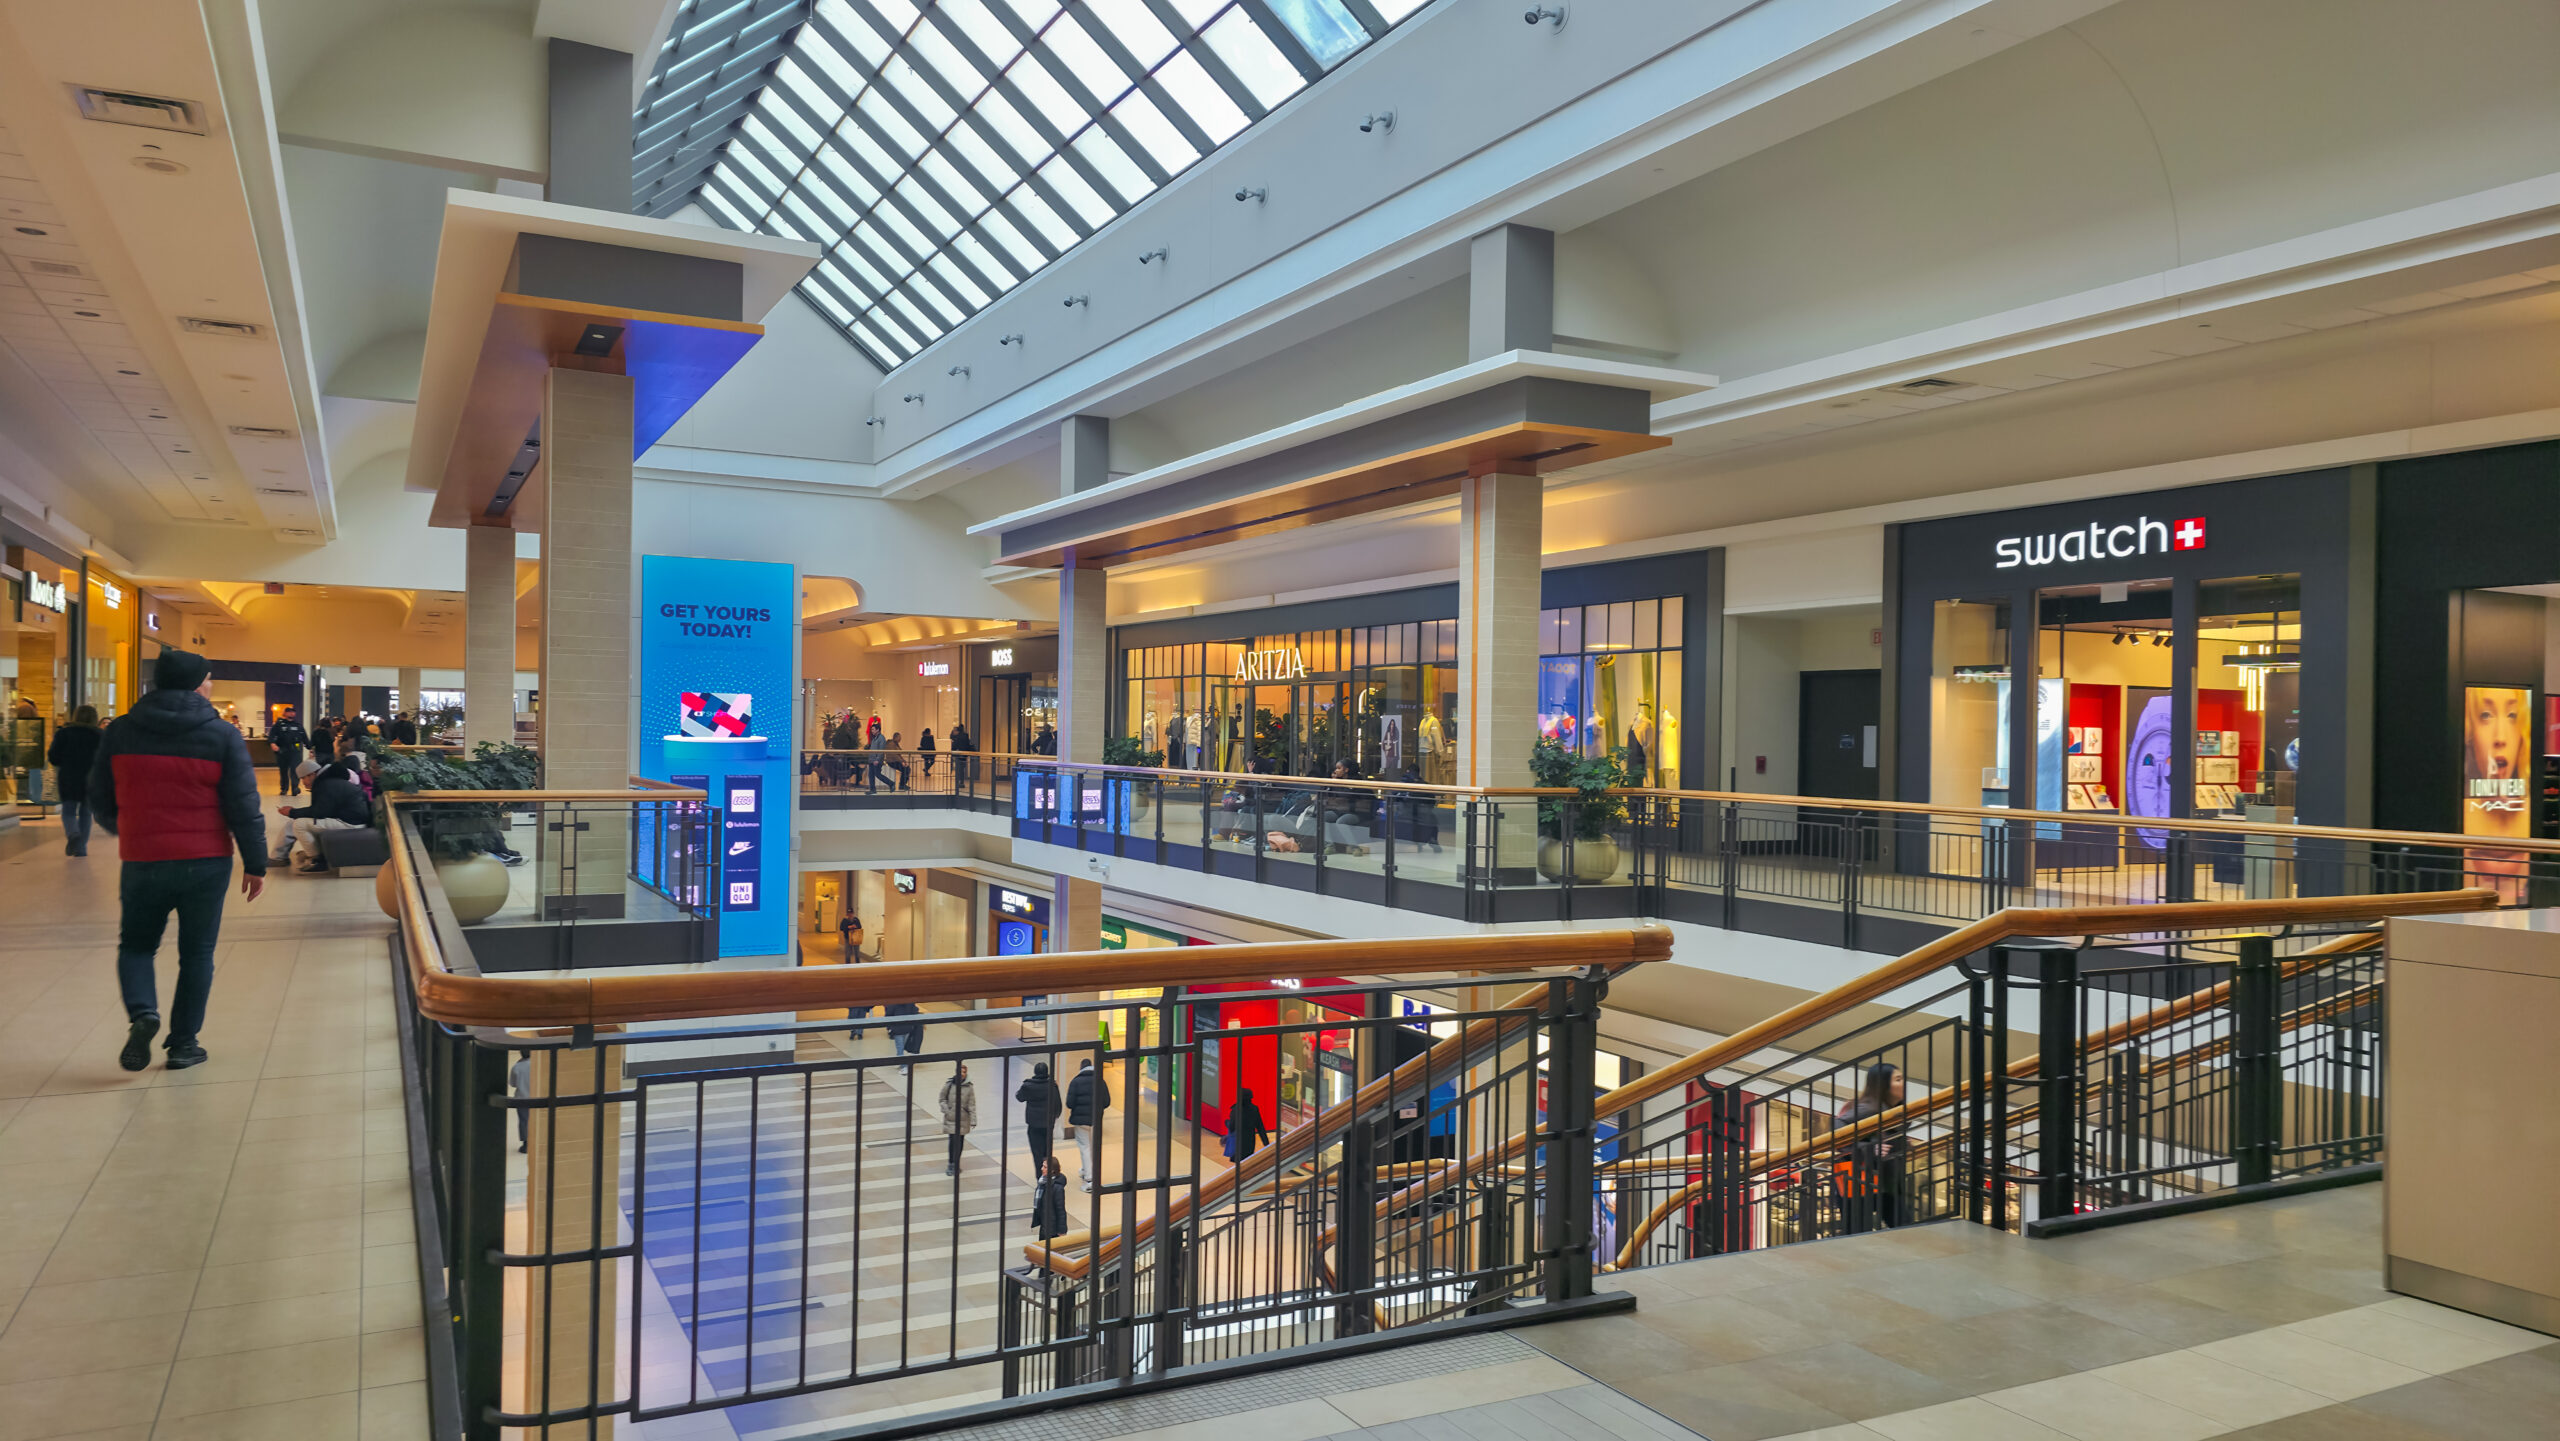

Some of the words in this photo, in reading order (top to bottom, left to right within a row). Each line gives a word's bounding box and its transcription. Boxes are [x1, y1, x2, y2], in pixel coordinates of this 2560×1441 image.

[1996, 516, 2169, 568] swatch
[660, 603, 699, 618] GET
[704, 605, 771, 622] YOURS
[680, 622, 752, 639] TODAY!
[991, 648, 1013, 667] BOSS
[1235, 647, 1307, 681] ARITZIA
[2470, 778, 2475, 797] I
[733, 795, 754, 806] LEGO
[733, 885, 750, 893] UNI
[733, 894, 750, 902] QLO
